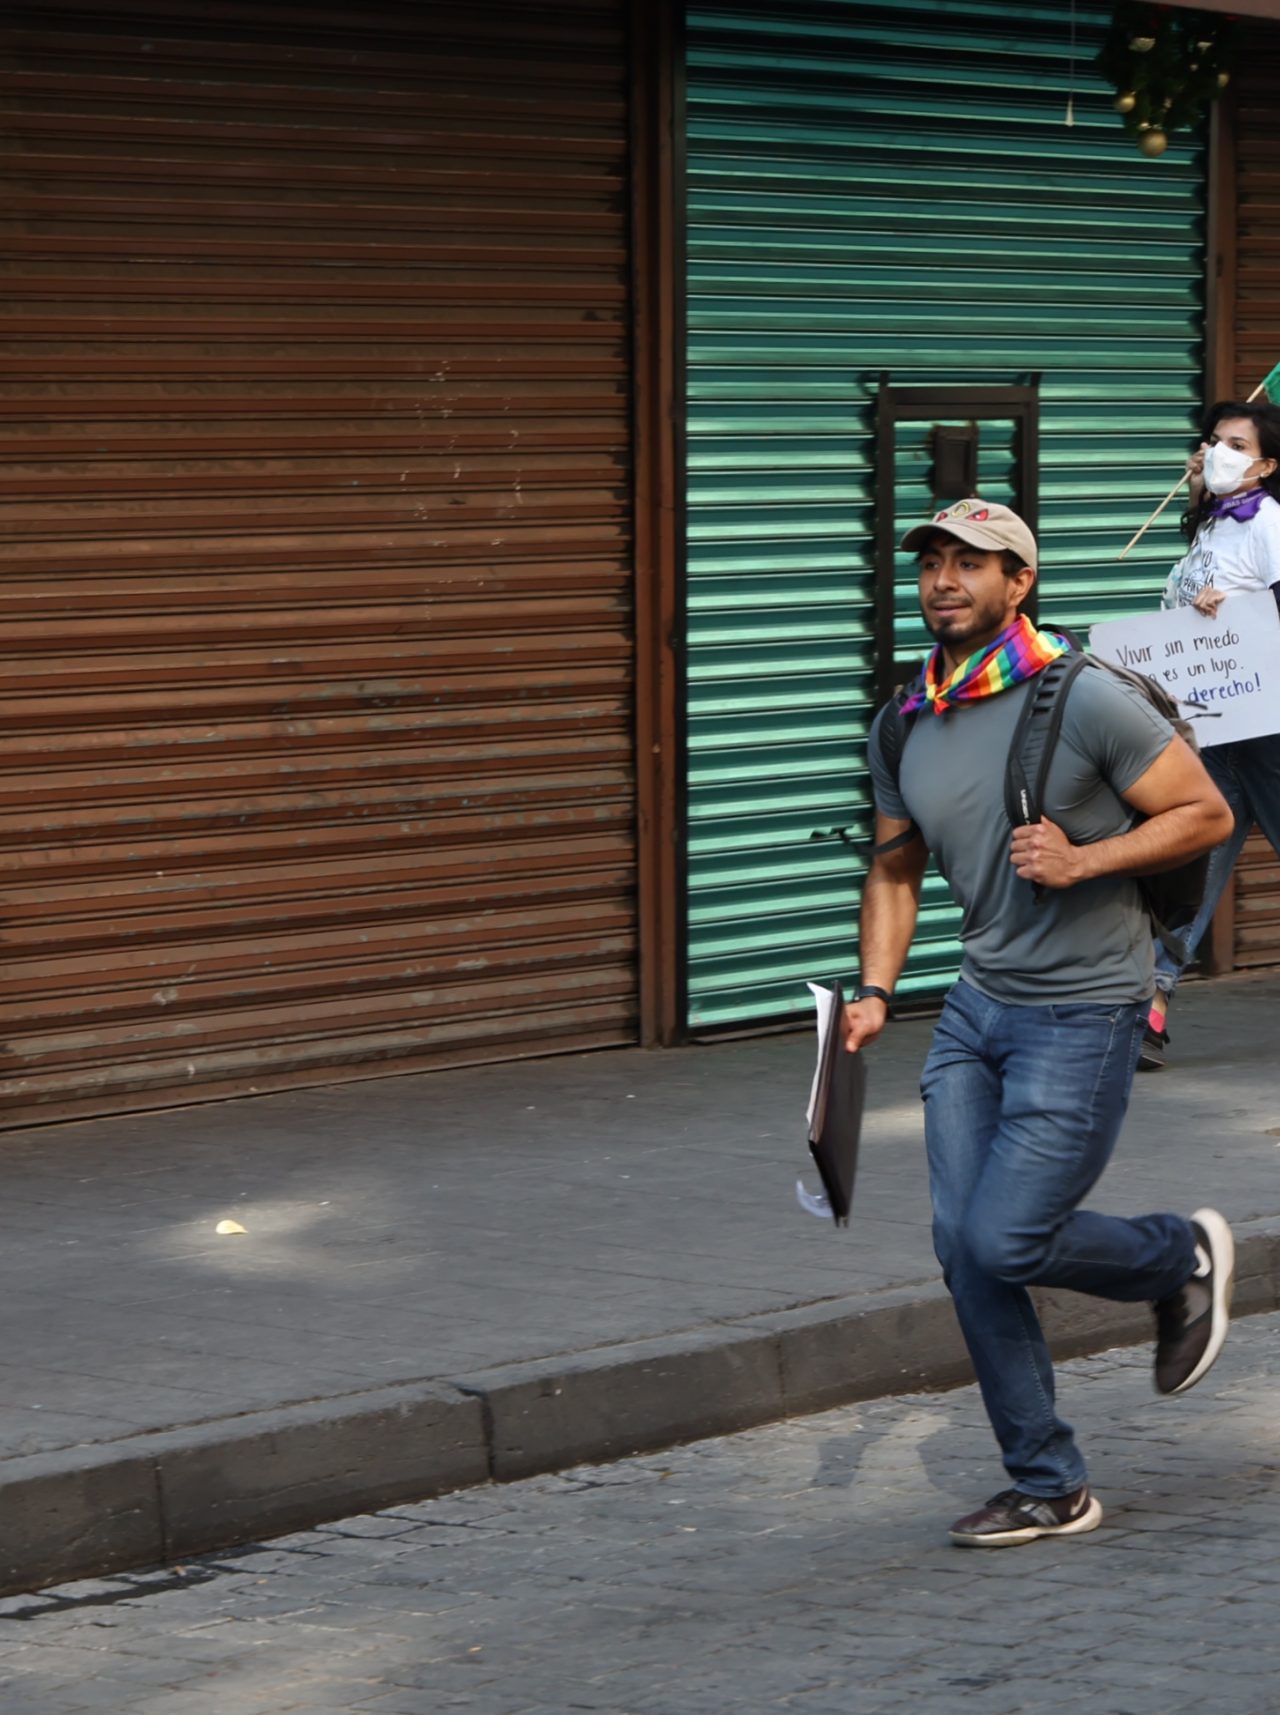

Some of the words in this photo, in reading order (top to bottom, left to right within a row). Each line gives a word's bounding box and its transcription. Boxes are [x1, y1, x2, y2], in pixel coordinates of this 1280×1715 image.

[1116, 645, 1153, 667] Vivir
[1164, 640, 1184, 658] sin
[1193, 629, 1240, 650] miedo
[1163, 668, 1178, 682] es
[1187, 663, 1206, 677] un
[1210, 657, 1244, 679] lujo.
[1187, 672, 1261, 704] derecho!
